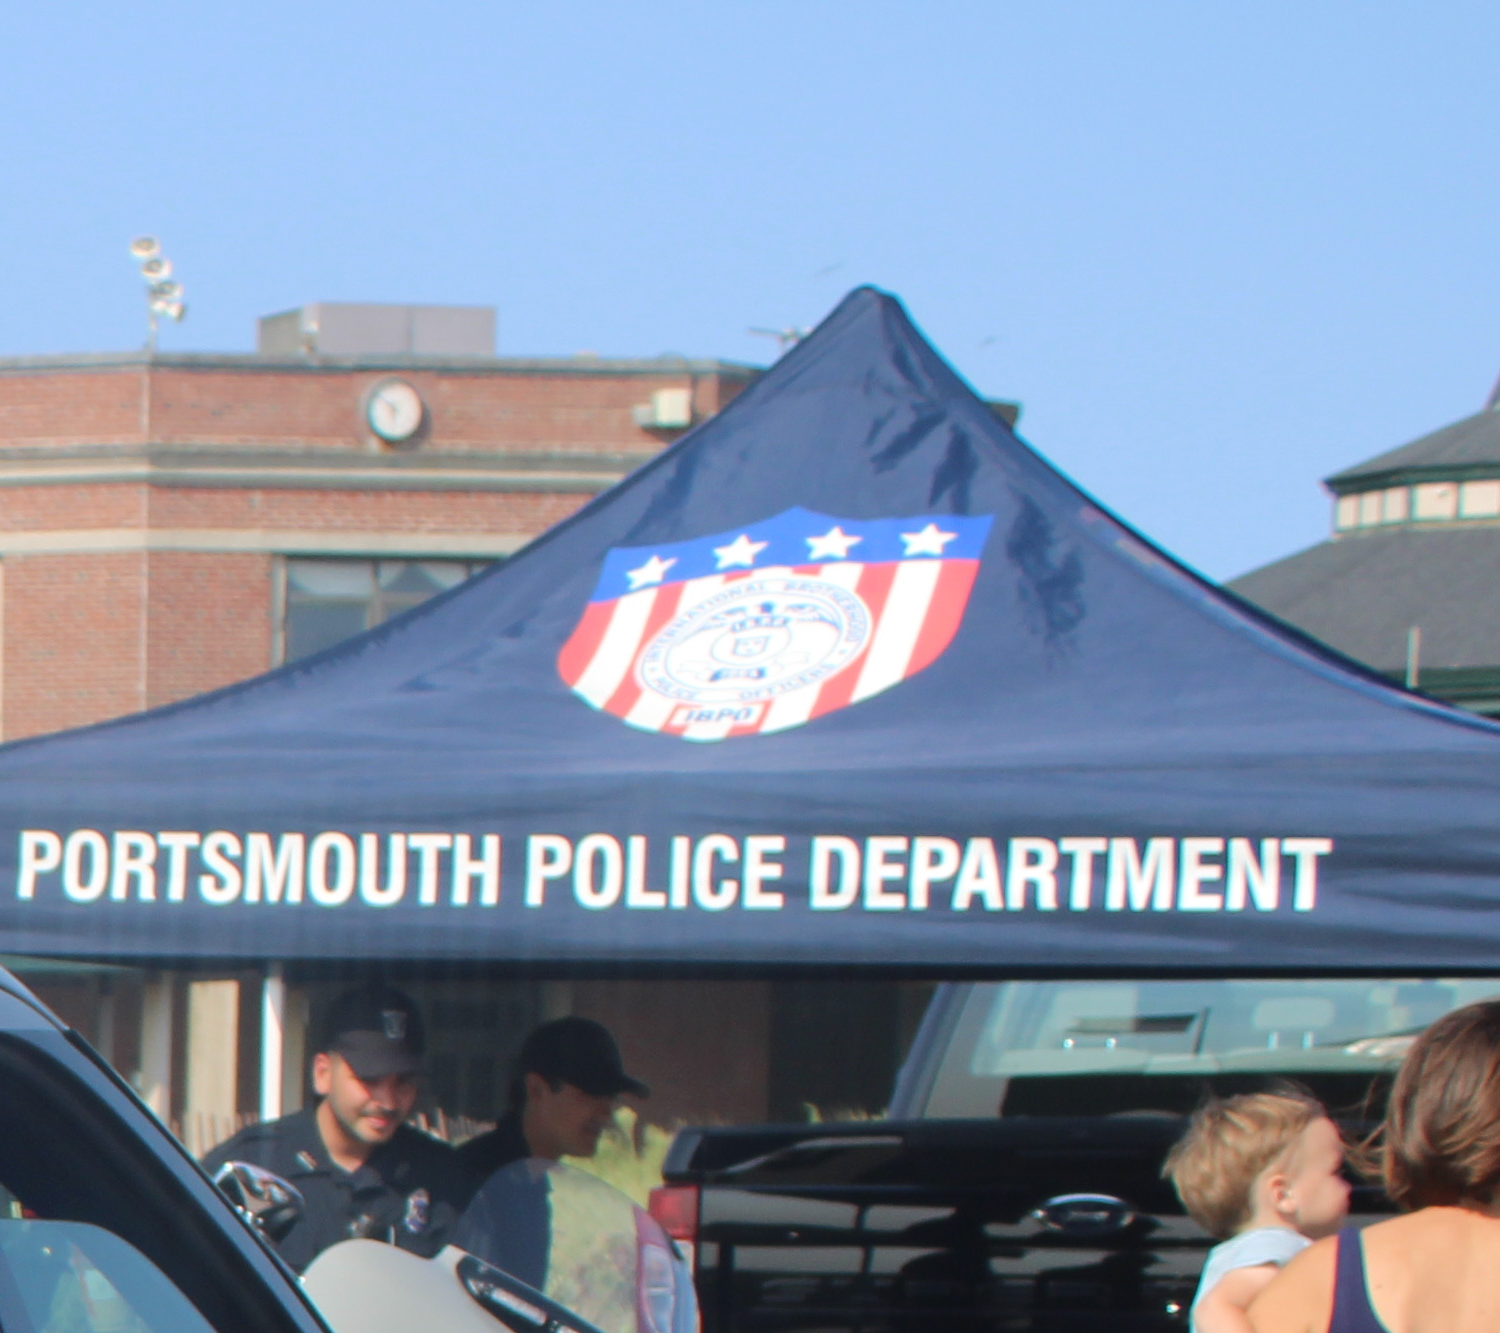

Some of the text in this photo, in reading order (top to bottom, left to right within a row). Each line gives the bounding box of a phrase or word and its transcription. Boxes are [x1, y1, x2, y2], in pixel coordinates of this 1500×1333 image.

[17, 829, 1333, 913] PORTSMOUTH POLICE DEPARTMENT
